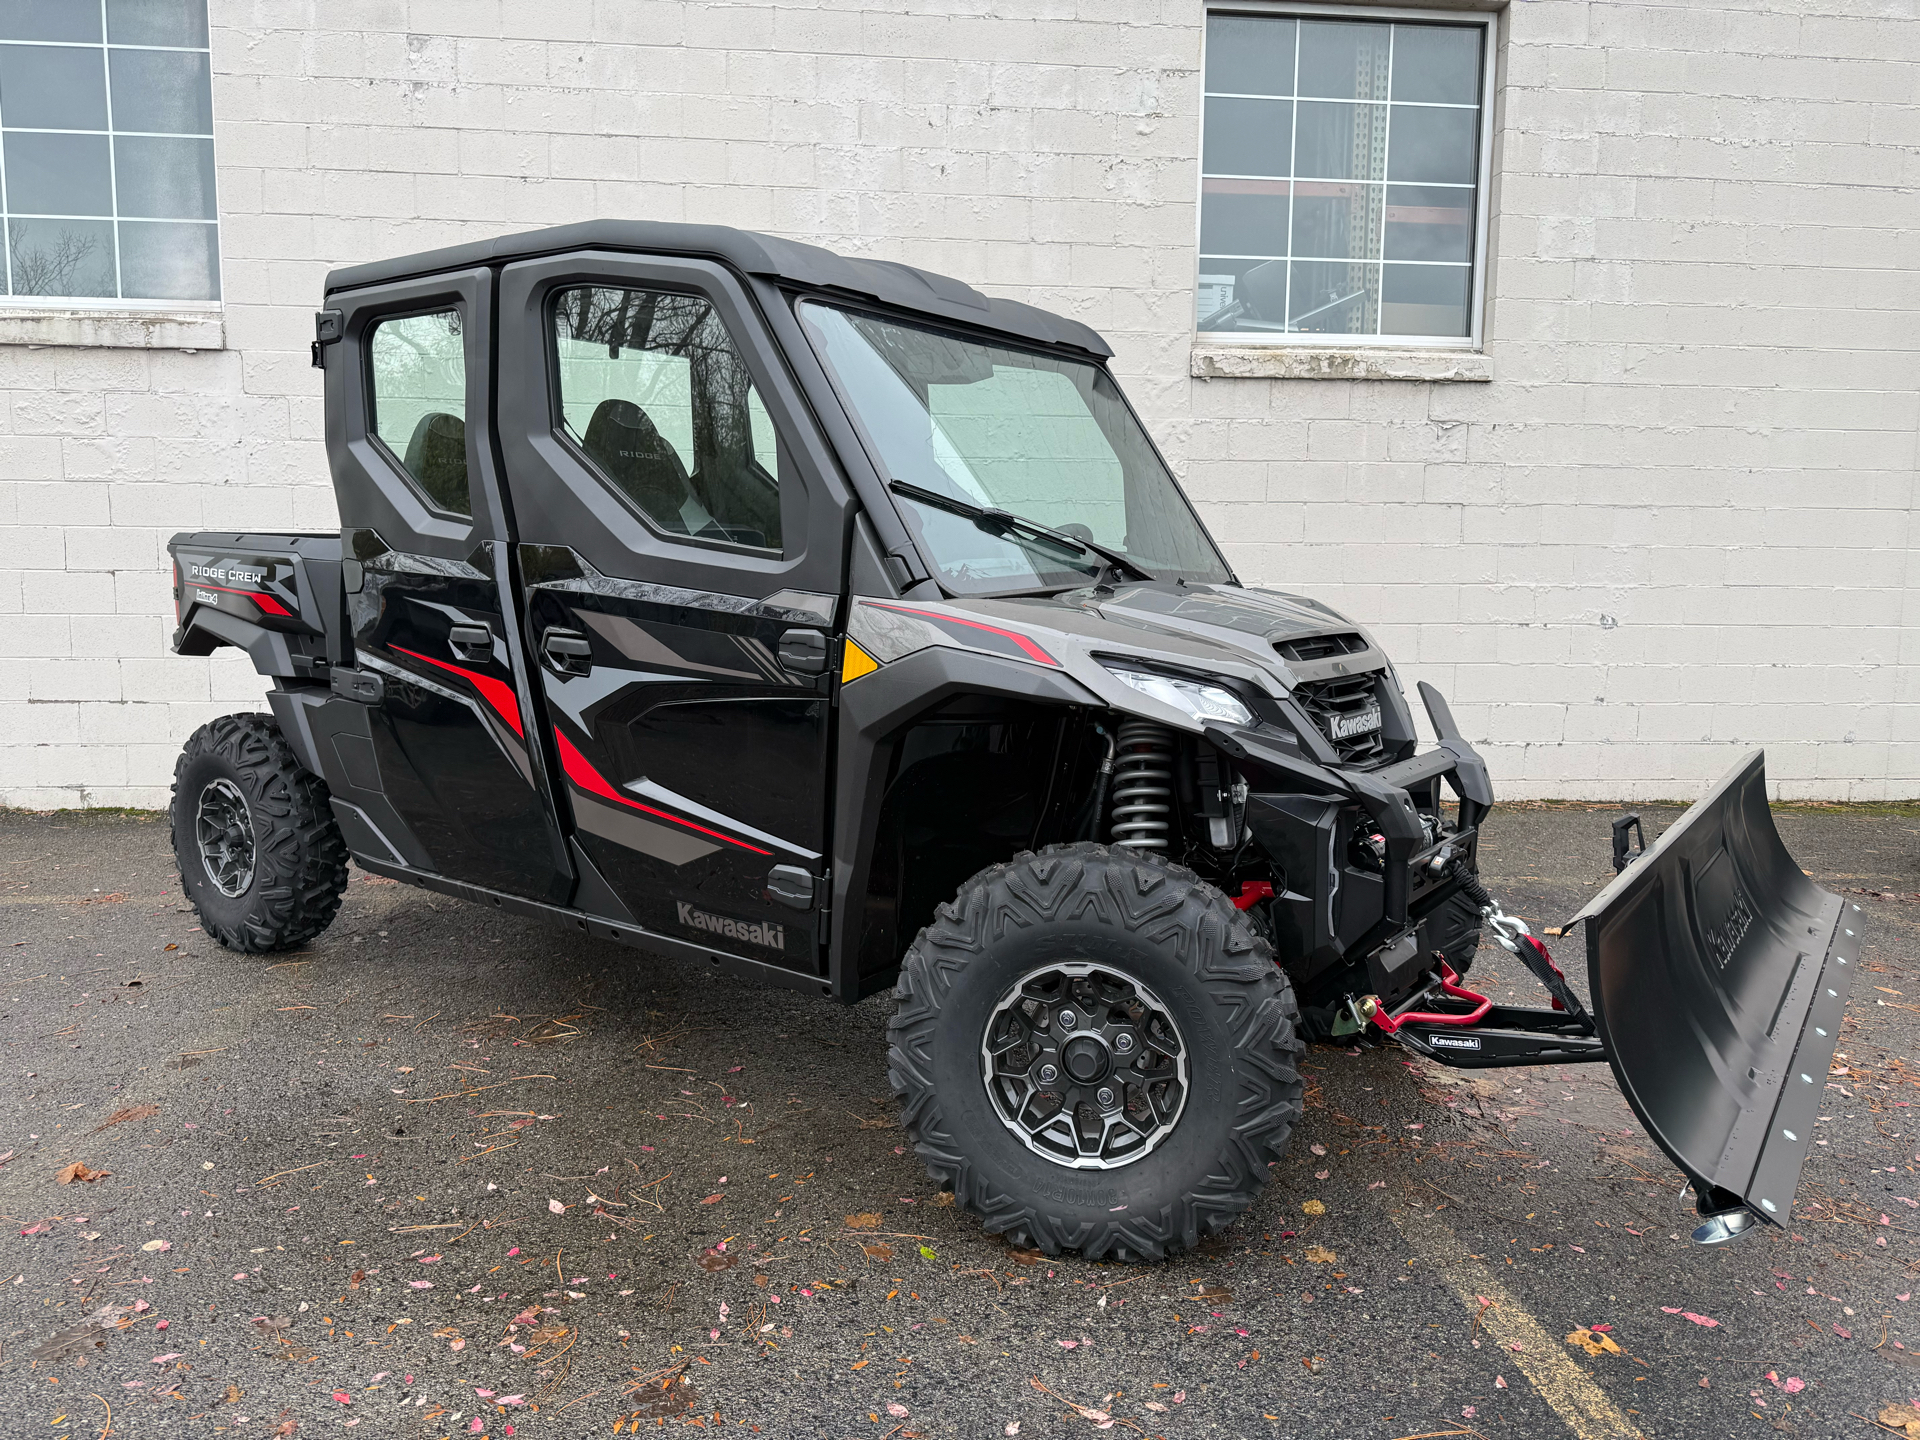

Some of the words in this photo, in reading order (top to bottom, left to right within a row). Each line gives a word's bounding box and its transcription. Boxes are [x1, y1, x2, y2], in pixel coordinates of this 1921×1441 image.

[619, 450, 661, 460] RIDGE
[191, 565, 226, 579] RIDGE
[228, 569, 262, 583] CREW
[1330, 708, 1382, 740] Kawasaki
[676, 900, 785, 950] Kawasaki
[1707, 887, 1753, 970] Kawasaki
[1431, 1036, 1479, 1048] Kawasaki
